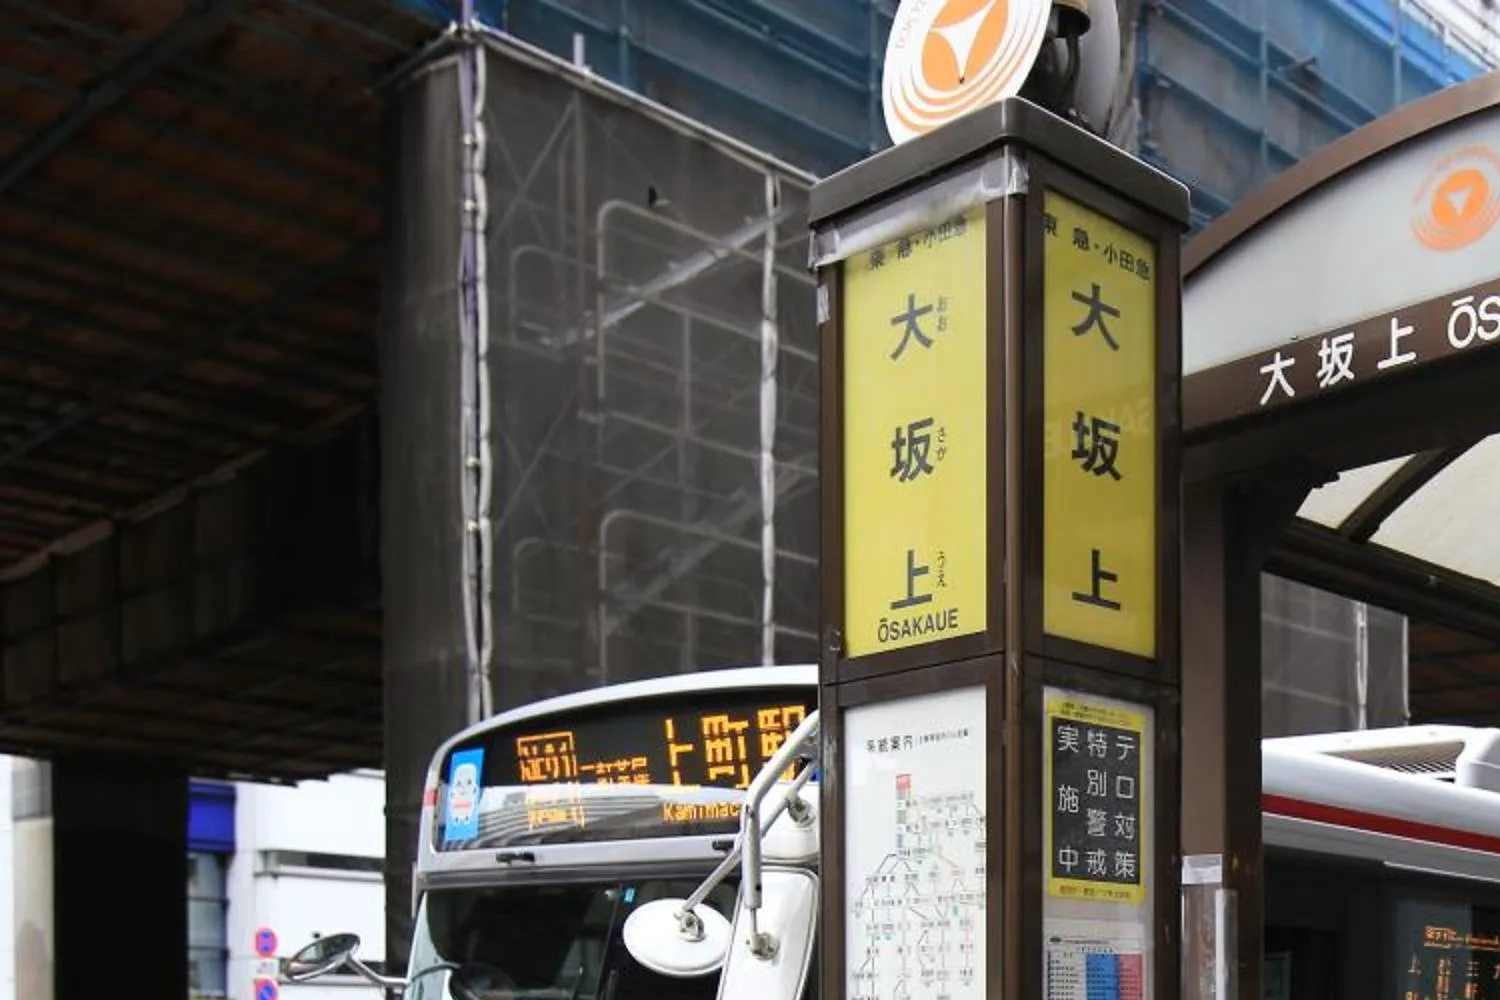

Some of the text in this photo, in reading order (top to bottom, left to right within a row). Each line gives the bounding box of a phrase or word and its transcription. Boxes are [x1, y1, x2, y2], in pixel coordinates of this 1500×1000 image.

[1260, 317, 1415, 405] 大坂上
[890, 293, 934, 610] 大坂上
[1071, 283, 1121, 611] 大坂上
[1057, 724, 1080, 873] 実施中
[1086, 730, 1108, 876] 特別警戒
[1114, 735, 1136, 879] テロ対策
